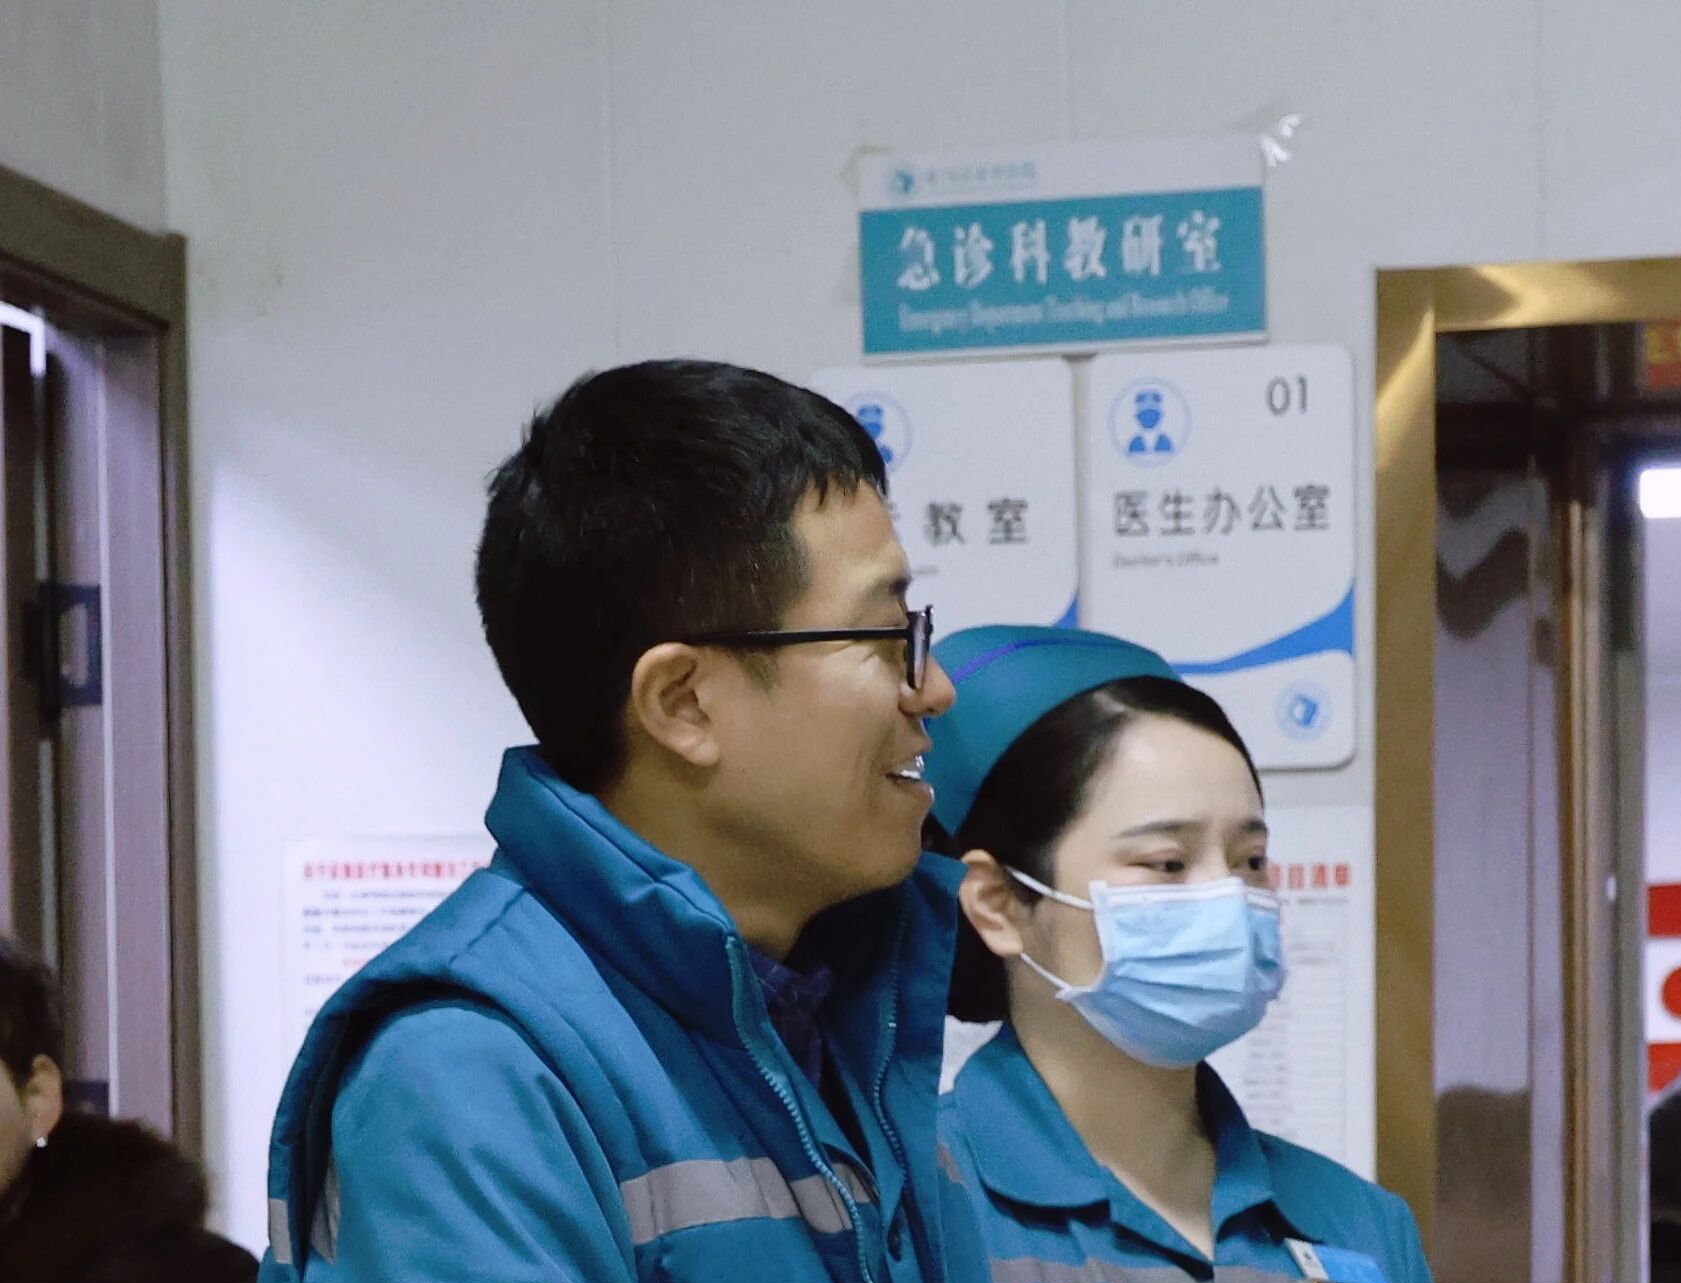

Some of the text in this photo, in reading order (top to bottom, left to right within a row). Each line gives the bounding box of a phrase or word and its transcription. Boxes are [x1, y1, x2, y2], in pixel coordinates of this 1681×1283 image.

[897, 209, 1222, 291] 急诊科教研室
[1266, 376, 1309, 416] 01
[888, 497, 1029, 547] 教室
[1113, 484, 1331, 537] 医生办公室
